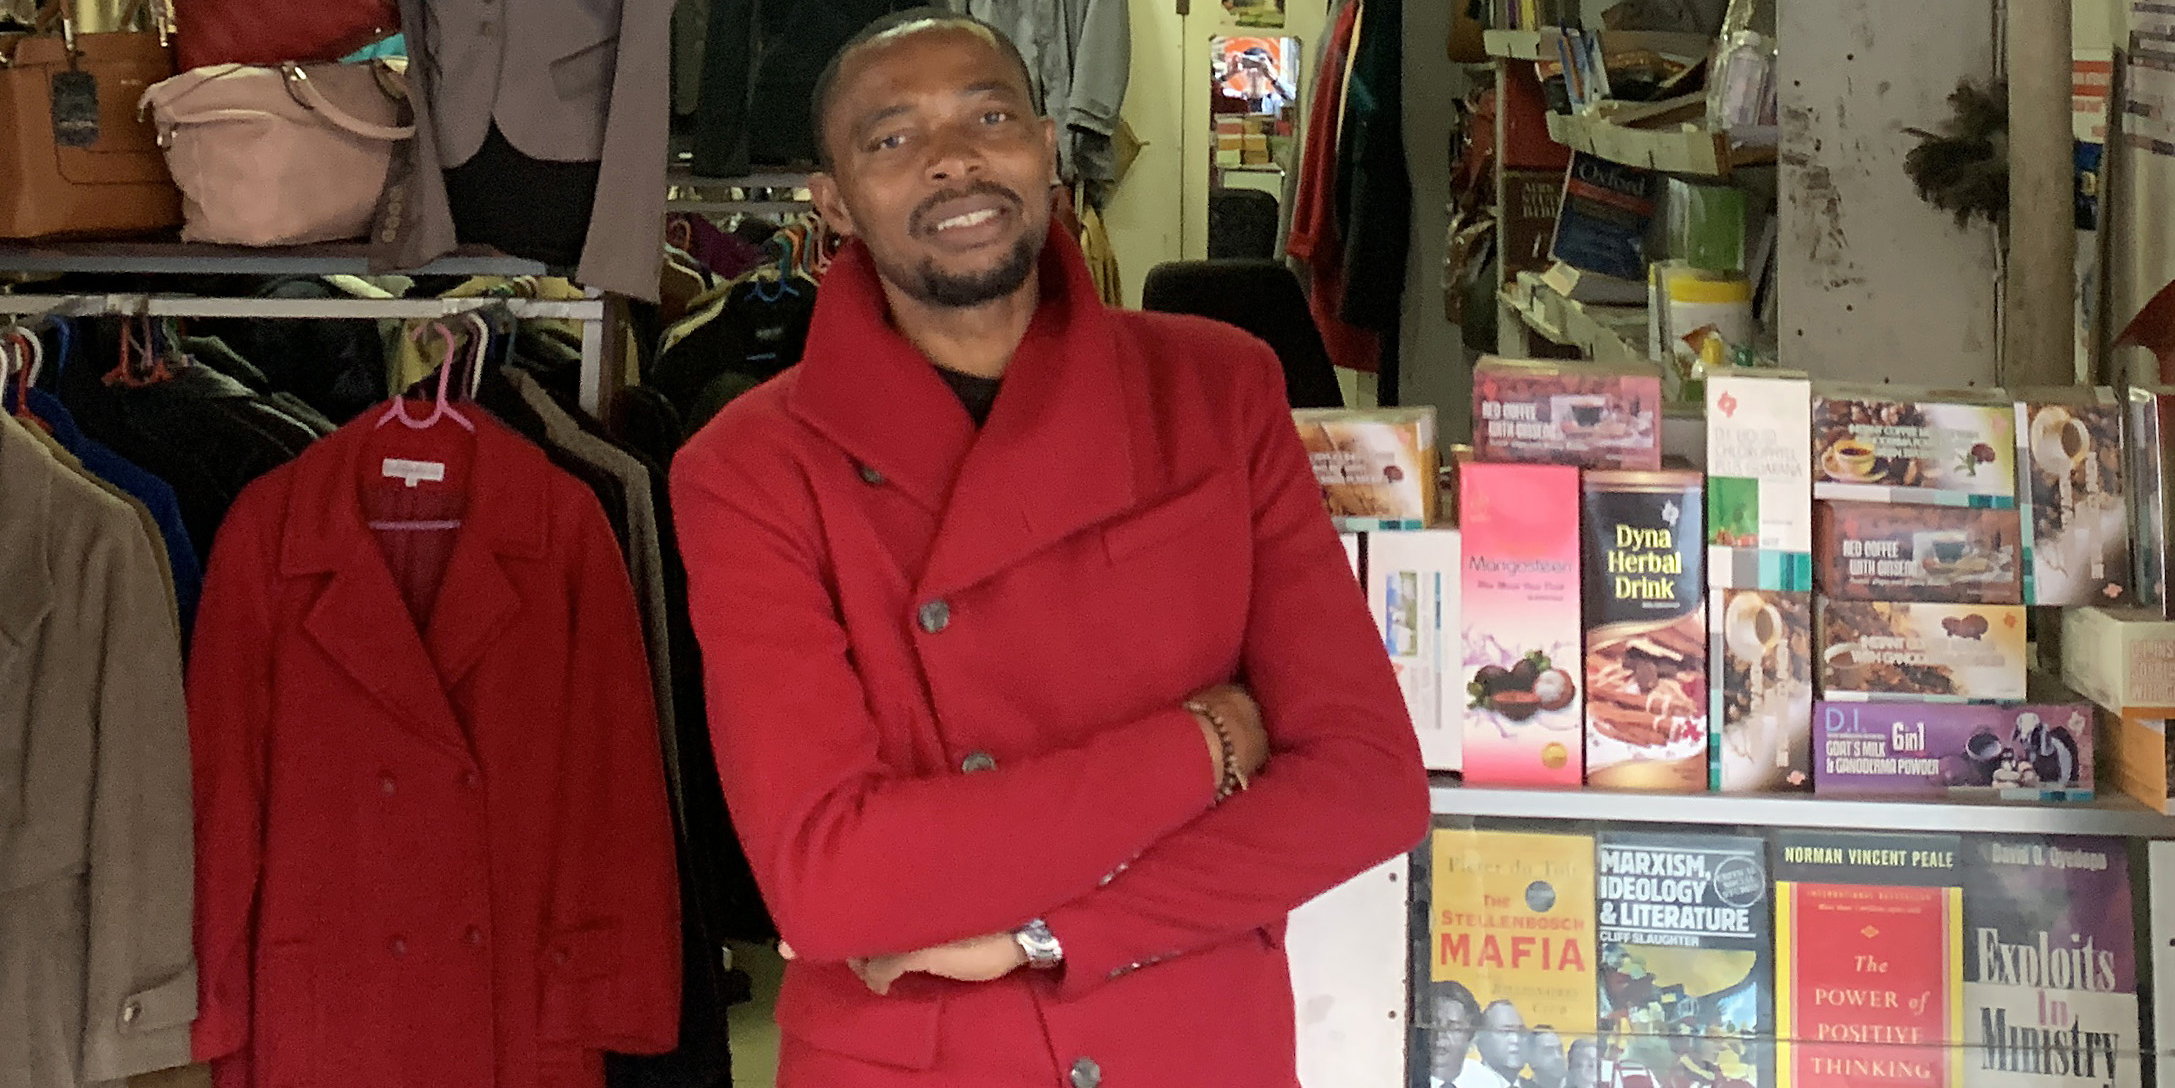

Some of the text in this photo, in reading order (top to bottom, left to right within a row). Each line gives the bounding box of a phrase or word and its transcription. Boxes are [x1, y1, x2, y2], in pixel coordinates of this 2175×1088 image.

[1616, 524, 1672, 551] Dyna
[1469, 556, 1572, 577] Mangosteen
[1608, 550, 1682, 574] Herbal
[1615, 575, 1675, 599] Drink
[1825, 706, 1867, 733] D.I.
[1892, 721, 1925, 751] 6in1
[1862, 741, 1886, 757] MILK
[1898, 758, 1940, 776] POWDER
[1600, 850, 1712, 881] MARXISM,
[1785, 847, 1954, 869] NORMAN VINCENT PEALE
[1599, 875, 1707, 904] IDEOLOGY
[1441, 909, 1585, 931] STELLENBOSCH
[1600, 902, 1750, 932] & LITERATURE
[1600, 932, 1700, 947] CLIFF SLAUGHTER
[1440, 933, 1586, 972] MAFIA
[1854, 954, 1889, 973] The
[1977, 927, 2117, 992] Exploits
[1815, 987, 1931, 1016] POWER of
[2037, 986, 2068, 1028] In
[1817, 1022, 1924, 1045] POSITIVE
[1980, 1007, 2120, 1088] Ministry
[1810, 1056, 1931, 1079] THINKING
